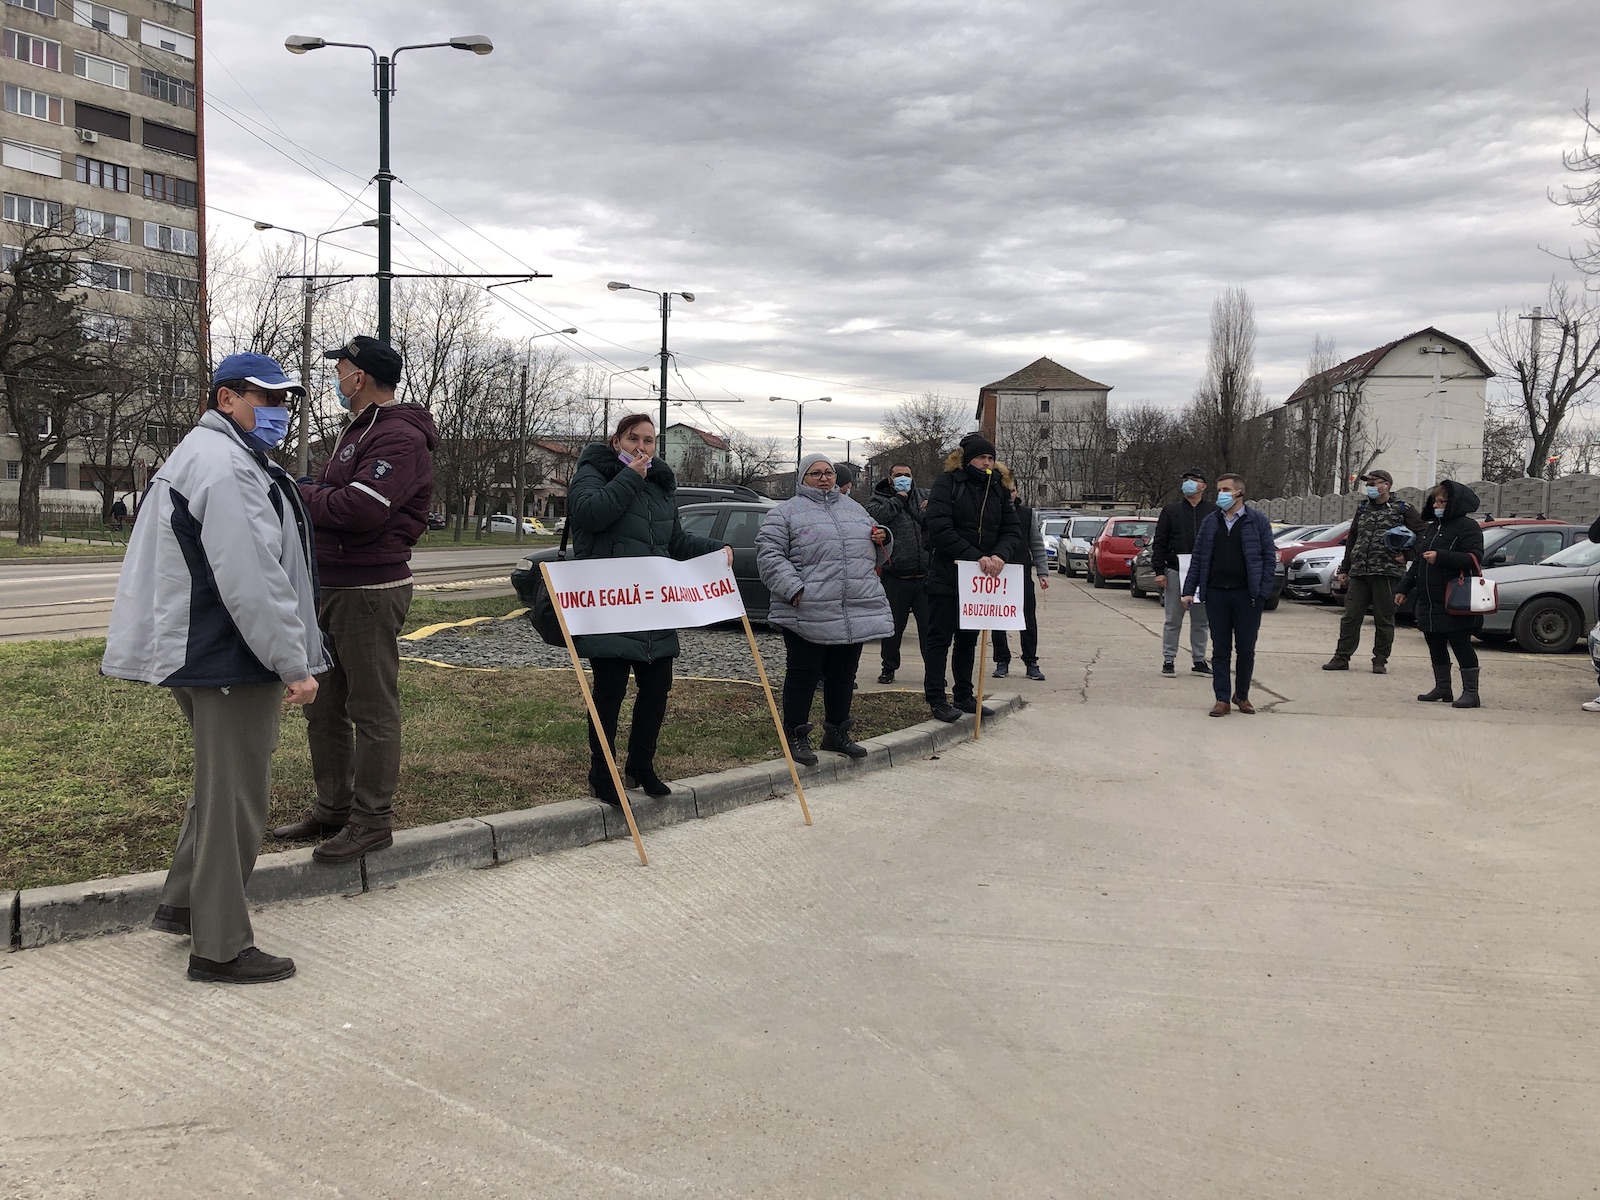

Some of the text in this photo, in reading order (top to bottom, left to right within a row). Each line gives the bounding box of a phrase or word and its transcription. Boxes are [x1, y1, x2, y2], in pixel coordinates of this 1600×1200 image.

[599, 584, 642, 606] EGALĂ
[702, 578, 735, 600] EGAL
[963, 603, 1016, 617] ABUZURILOR
